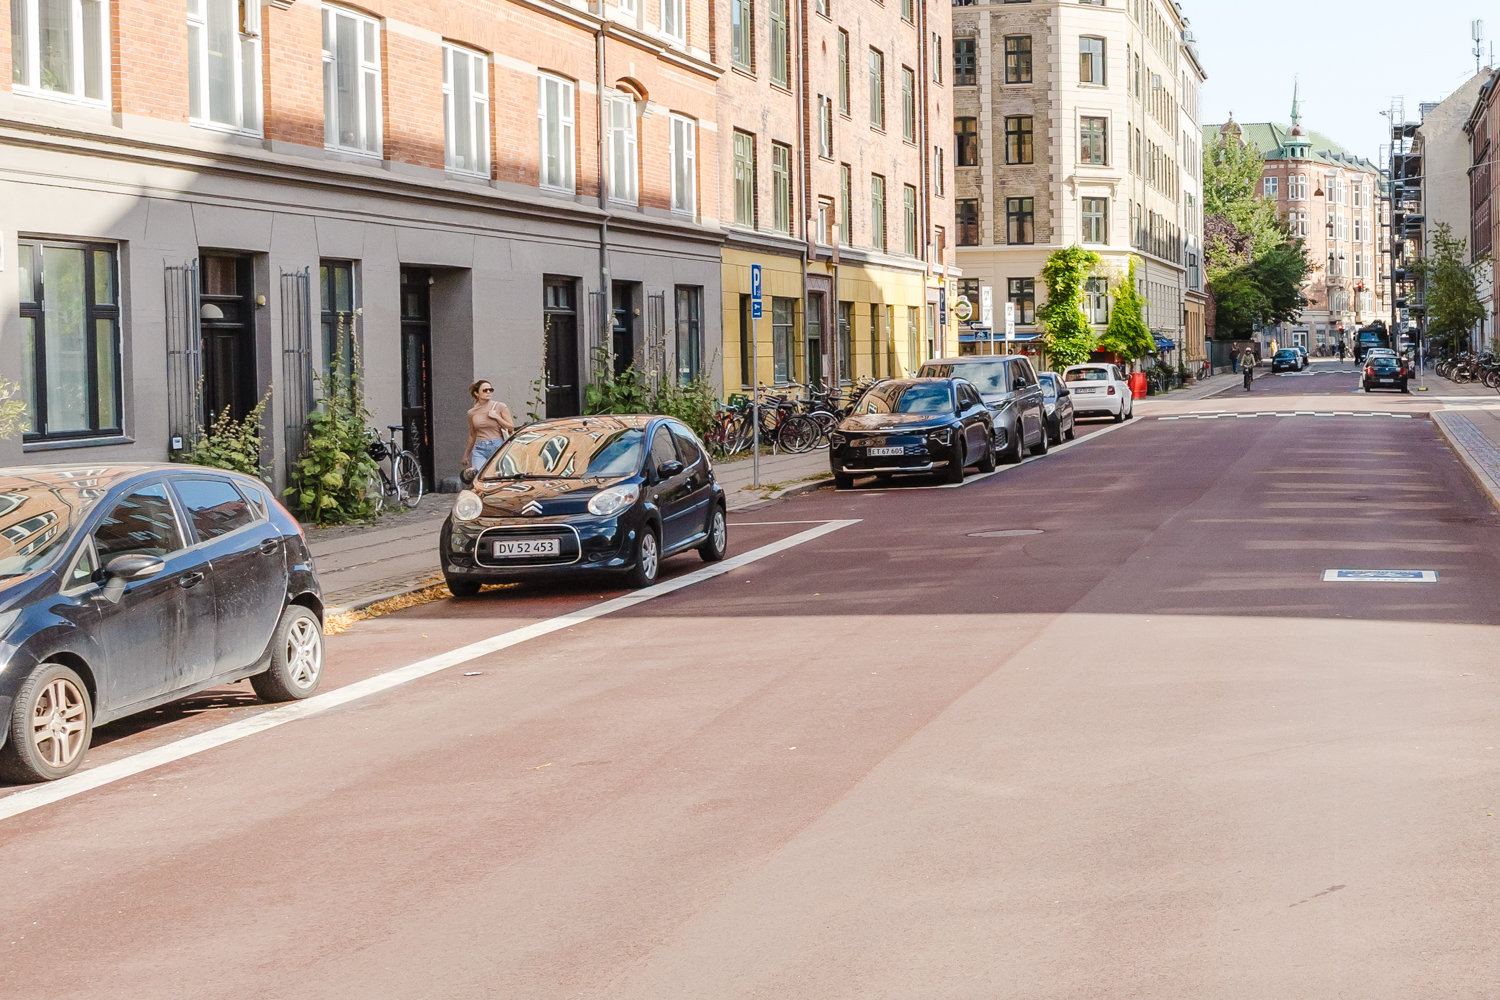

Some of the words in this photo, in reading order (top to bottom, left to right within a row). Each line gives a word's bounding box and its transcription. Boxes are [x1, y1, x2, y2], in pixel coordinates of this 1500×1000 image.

[499, 543, 515, 554] DV
[517, 543, 531, 553] 52
[533, 541, 554, 552] 453
